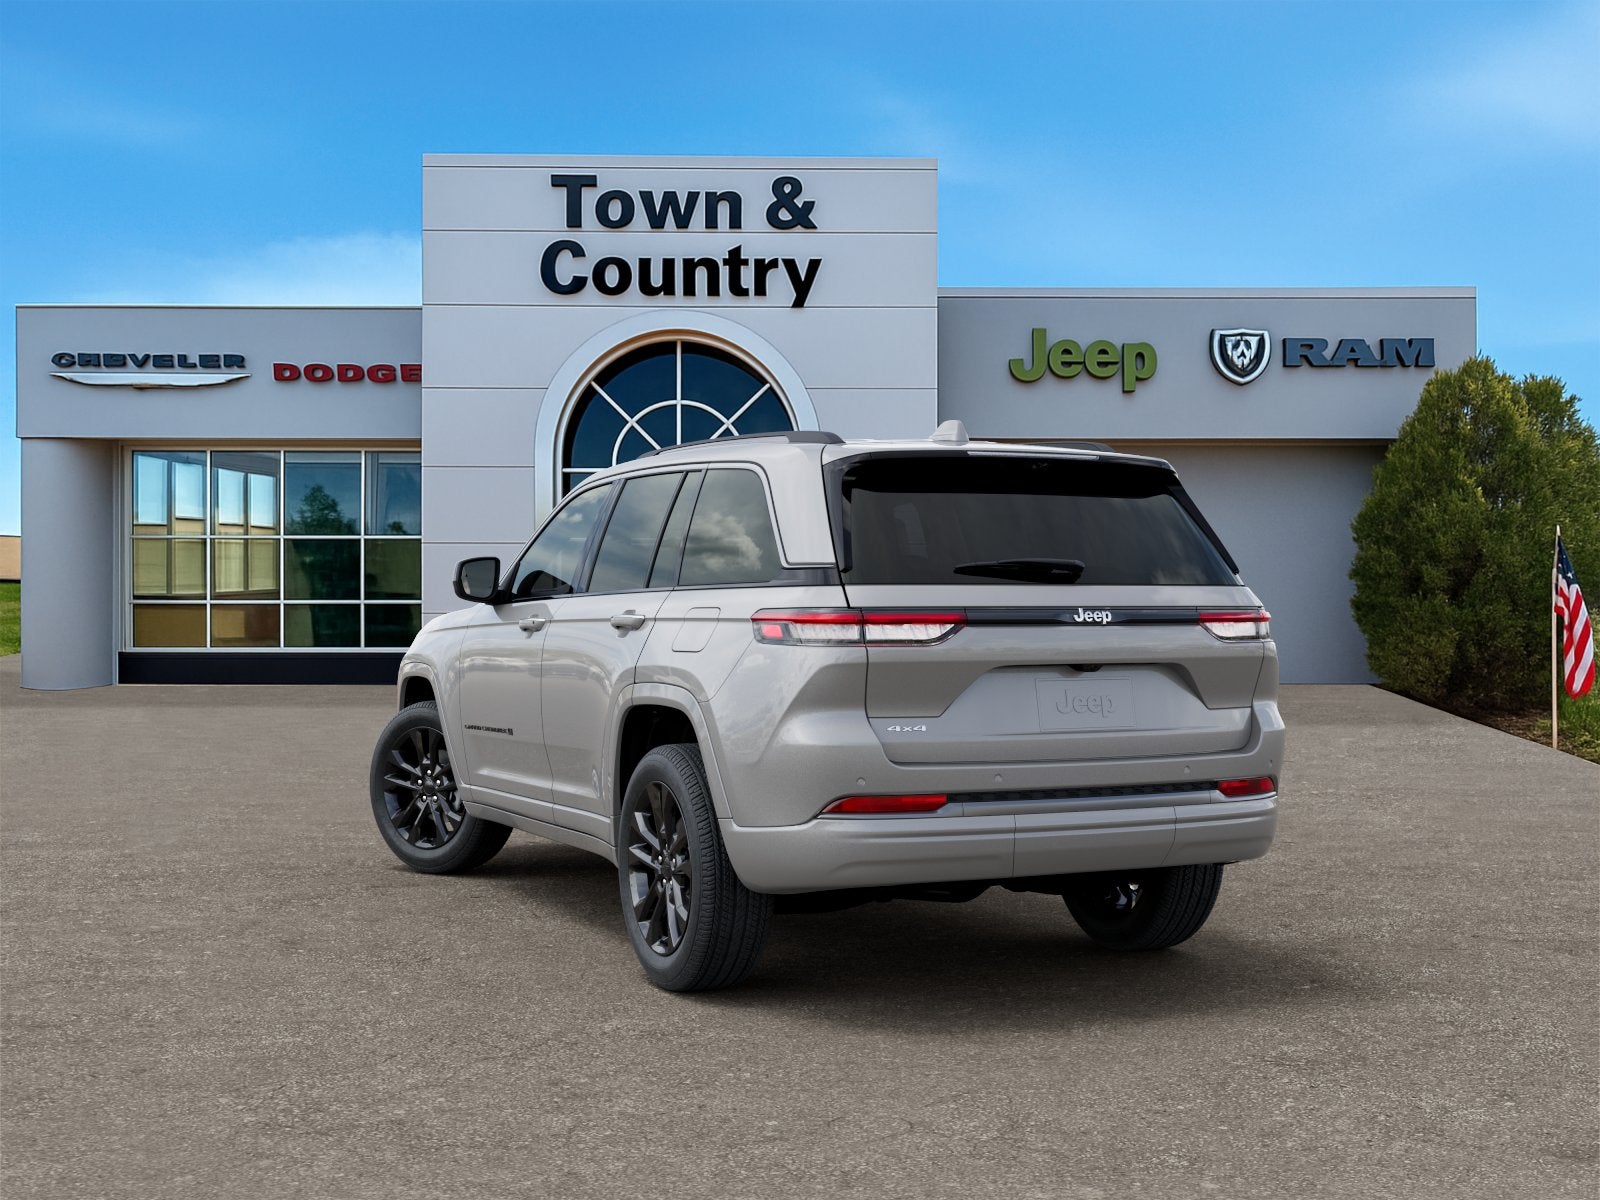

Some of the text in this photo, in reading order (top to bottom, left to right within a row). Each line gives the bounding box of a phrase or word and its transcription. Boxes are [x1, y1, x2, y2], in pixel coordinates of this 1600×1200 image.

[551, 174, 818, 230] Town &
[540, 239, 822, 308] Country
[1008, 327, 1158, 393] Jeep
[1282, 337, 1436, 368] RAM
[272, 363, 422, 383] DODGE
[1073, 607, 1112, 625] Jeep
[1055, 688, 1116, 719] Jeep
